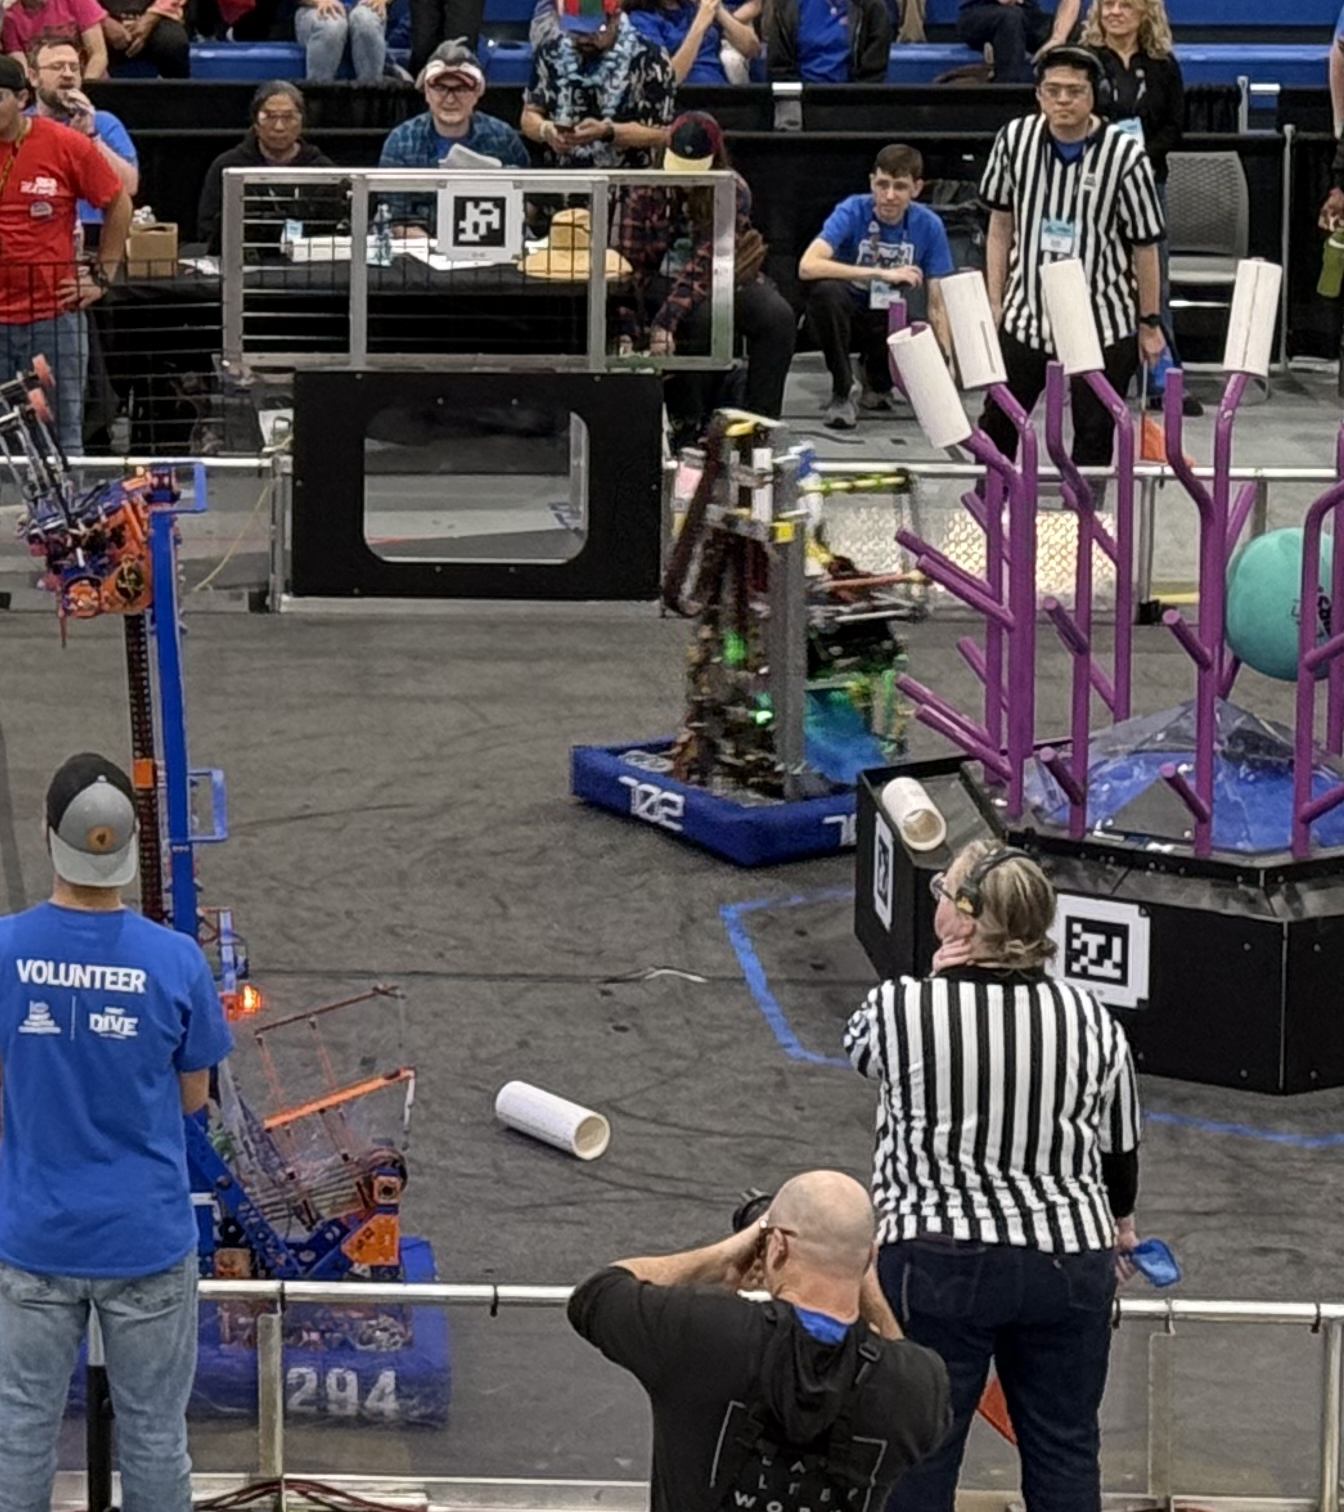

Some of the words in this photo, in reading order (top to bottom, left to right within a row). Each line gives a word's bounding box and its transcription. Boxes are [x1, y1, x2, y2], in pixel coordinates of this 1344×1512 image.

[16, 958, 147, 994] VOLUNTEER
[89, 1012, 139, 1037] DIVE
[286, 1367, 400, 1422] 294
